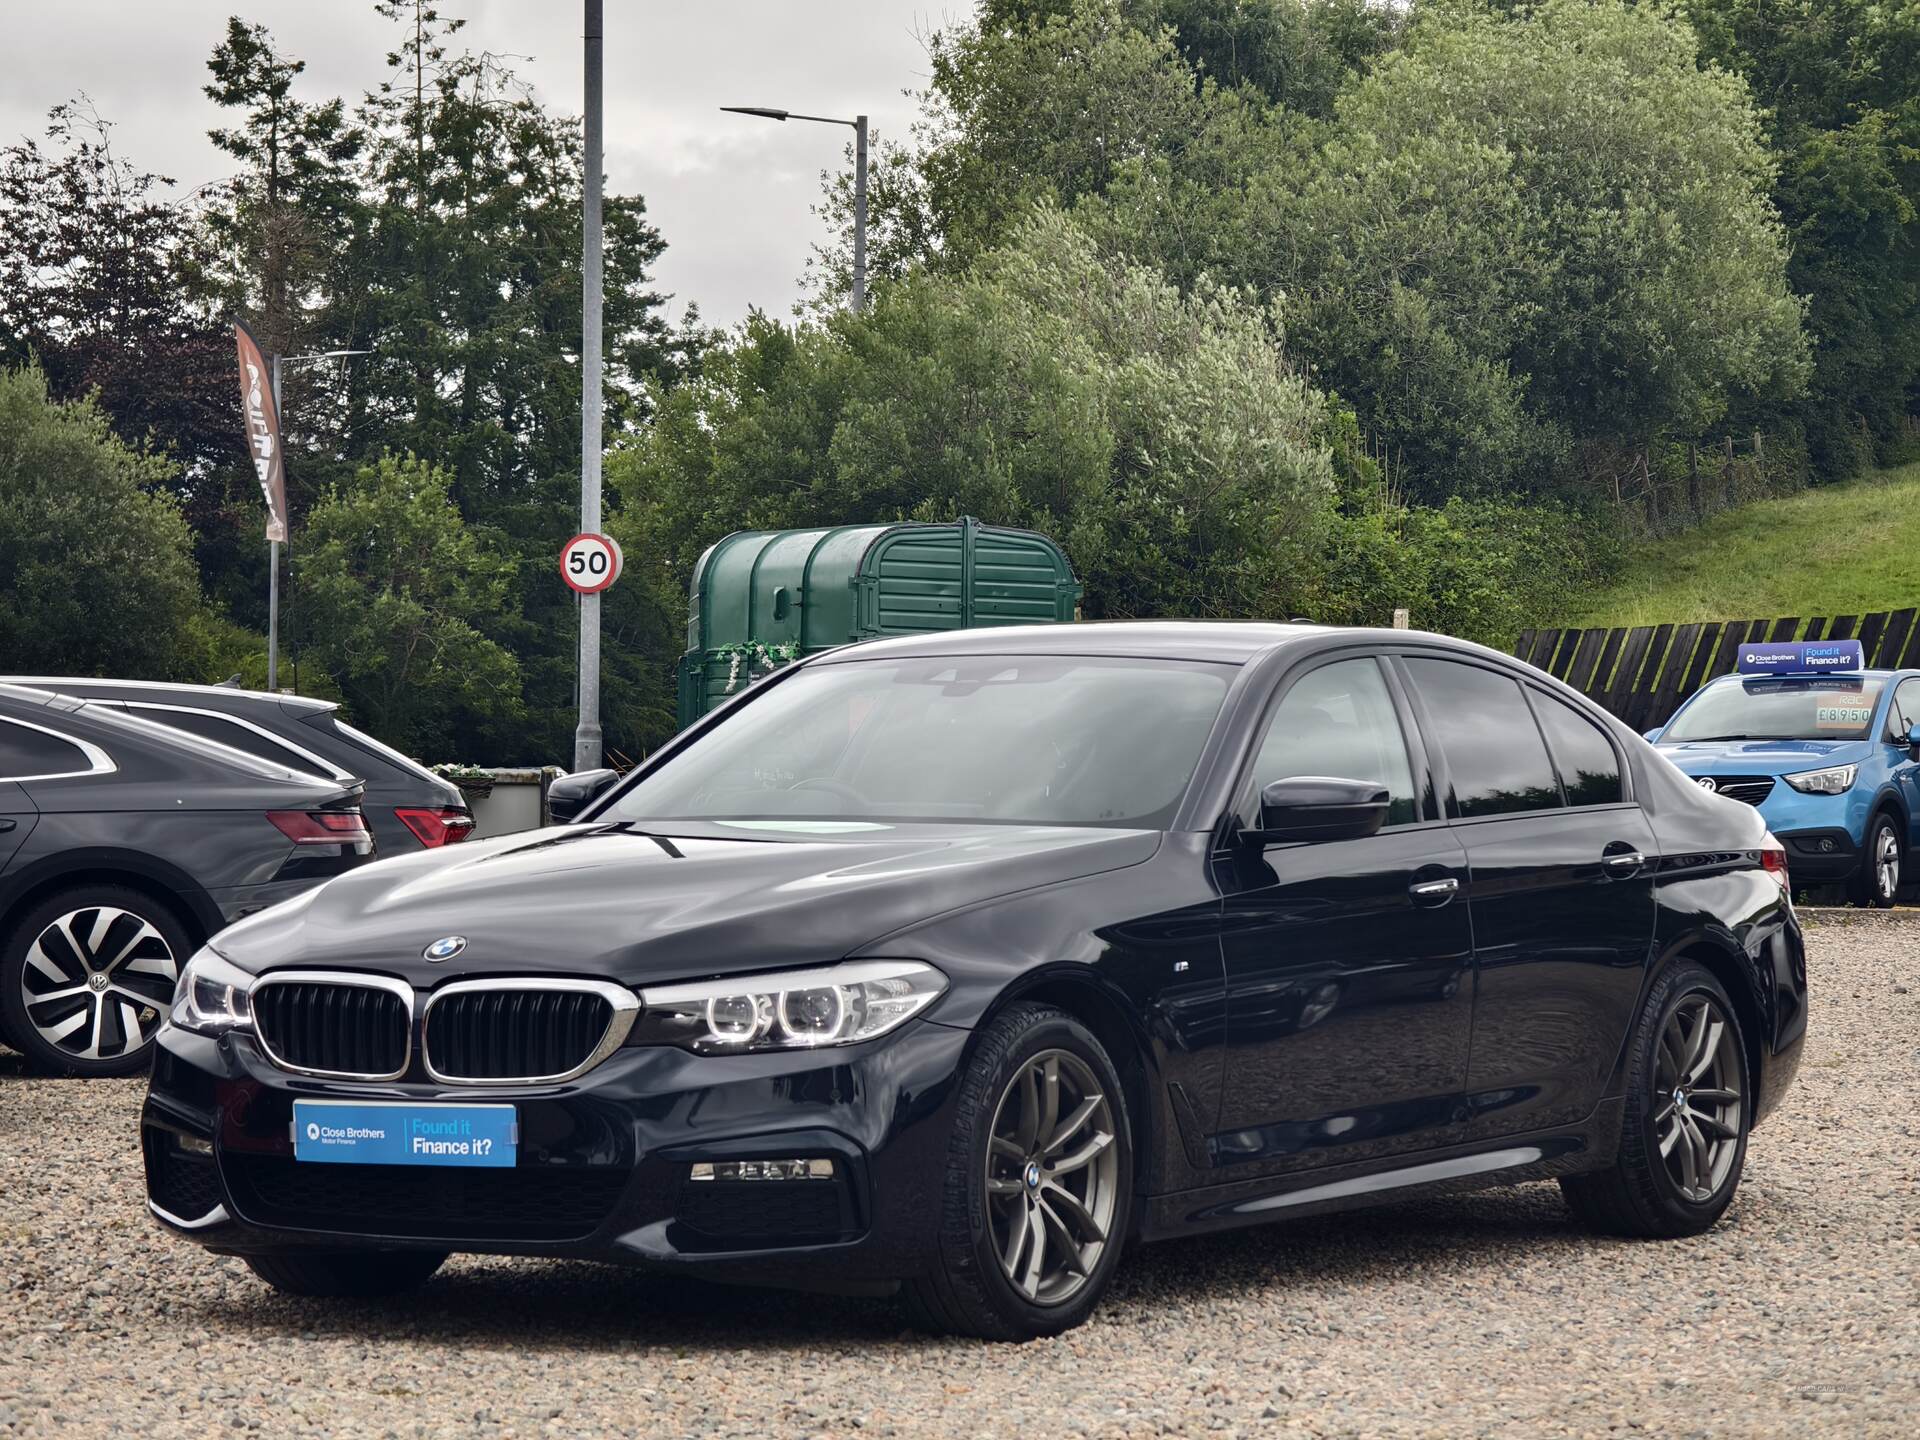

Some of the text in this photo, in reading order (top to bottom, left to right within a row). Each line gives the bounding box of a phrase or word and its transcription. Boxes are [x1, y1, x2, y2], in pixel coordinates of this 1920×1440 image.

[569, 551, 607, 575] 50
[1806, 647, 1840, 656] Found it
[1805, 655, 1851, 665] Finance it?
[1818, 709, 1870, 721] £8950
[321, 1127, 385, 1139] Close Brothers
[412, 1118, 472, 1136] Found it
[413, 1137, 492, 1155] Finance it?
